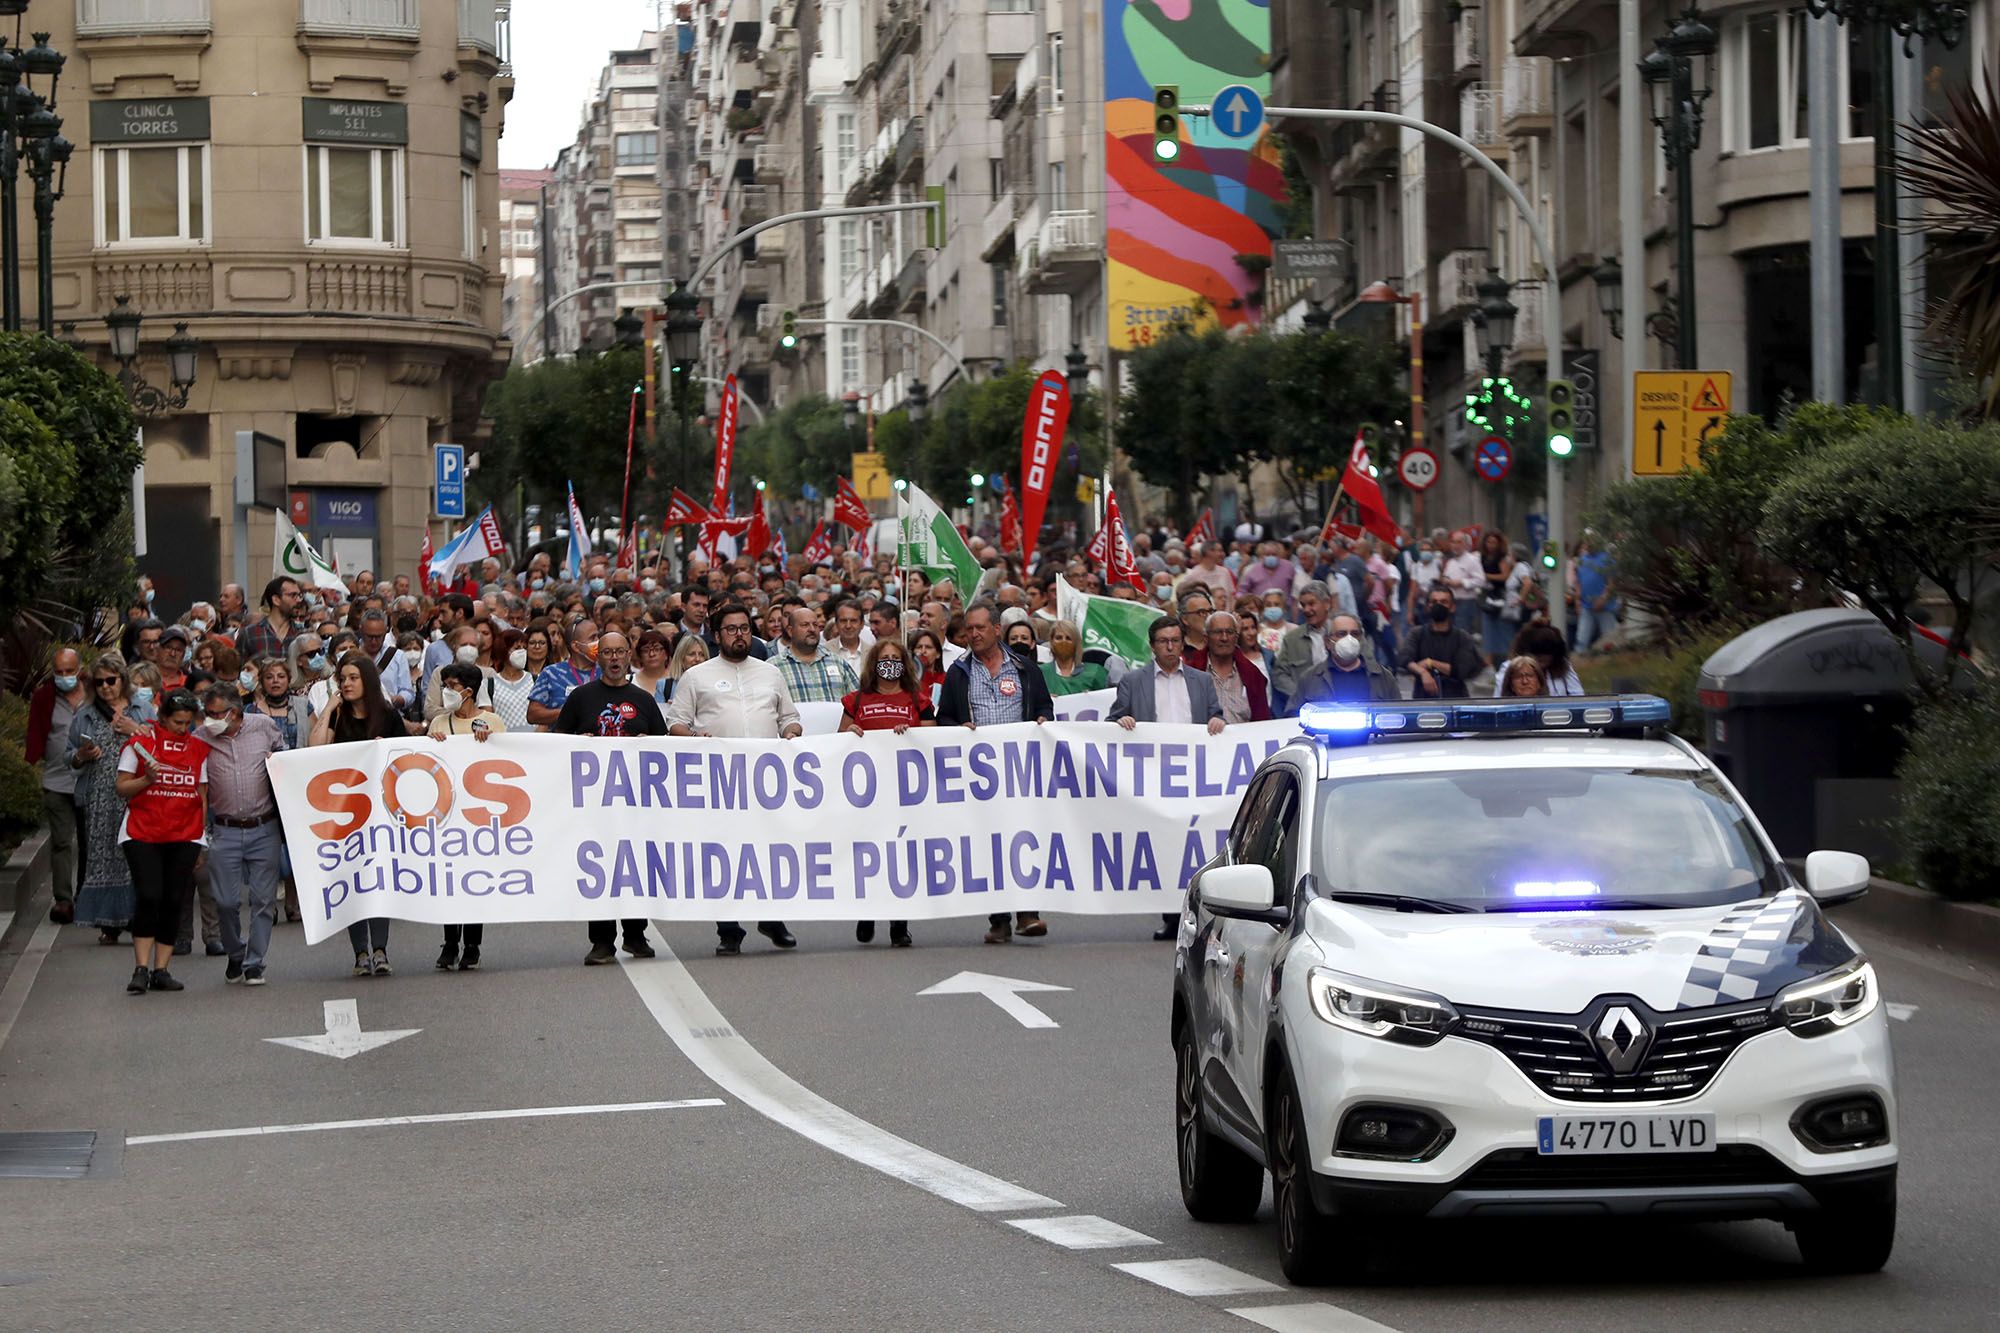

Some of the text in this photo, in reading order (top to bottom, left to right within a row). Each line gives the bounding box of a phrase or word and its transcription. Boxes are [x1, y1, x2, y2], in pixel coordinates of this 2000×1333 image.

[124, 104, 175, 118] CLINICA
[329, 104, 382, 117] IMPLANTES
[122, 121, 178, 135] TORRES
[1028, 391, 1058, 490] CCOO
[443, 453, 457, 481] P
[1406, 461, 1432, 475] 40
[329, 501, 362, 514] VIGO
[570, 736, 1284, 811] PAREMOS O DESMANTELA
[306, 752, 532, 841] SOS
[316, 816, 534, 872] sanidade
[576, 839, 835, 900] SANIDADE
[852, 825, 1075, 899] PÚBLICA
[1092, 831, 1161, 892] NA
[322, 858, 535, 920] pública
[1560, 1121, 1636, 1149] 4770
[1649, 1120, 1706, 1147] LVD
